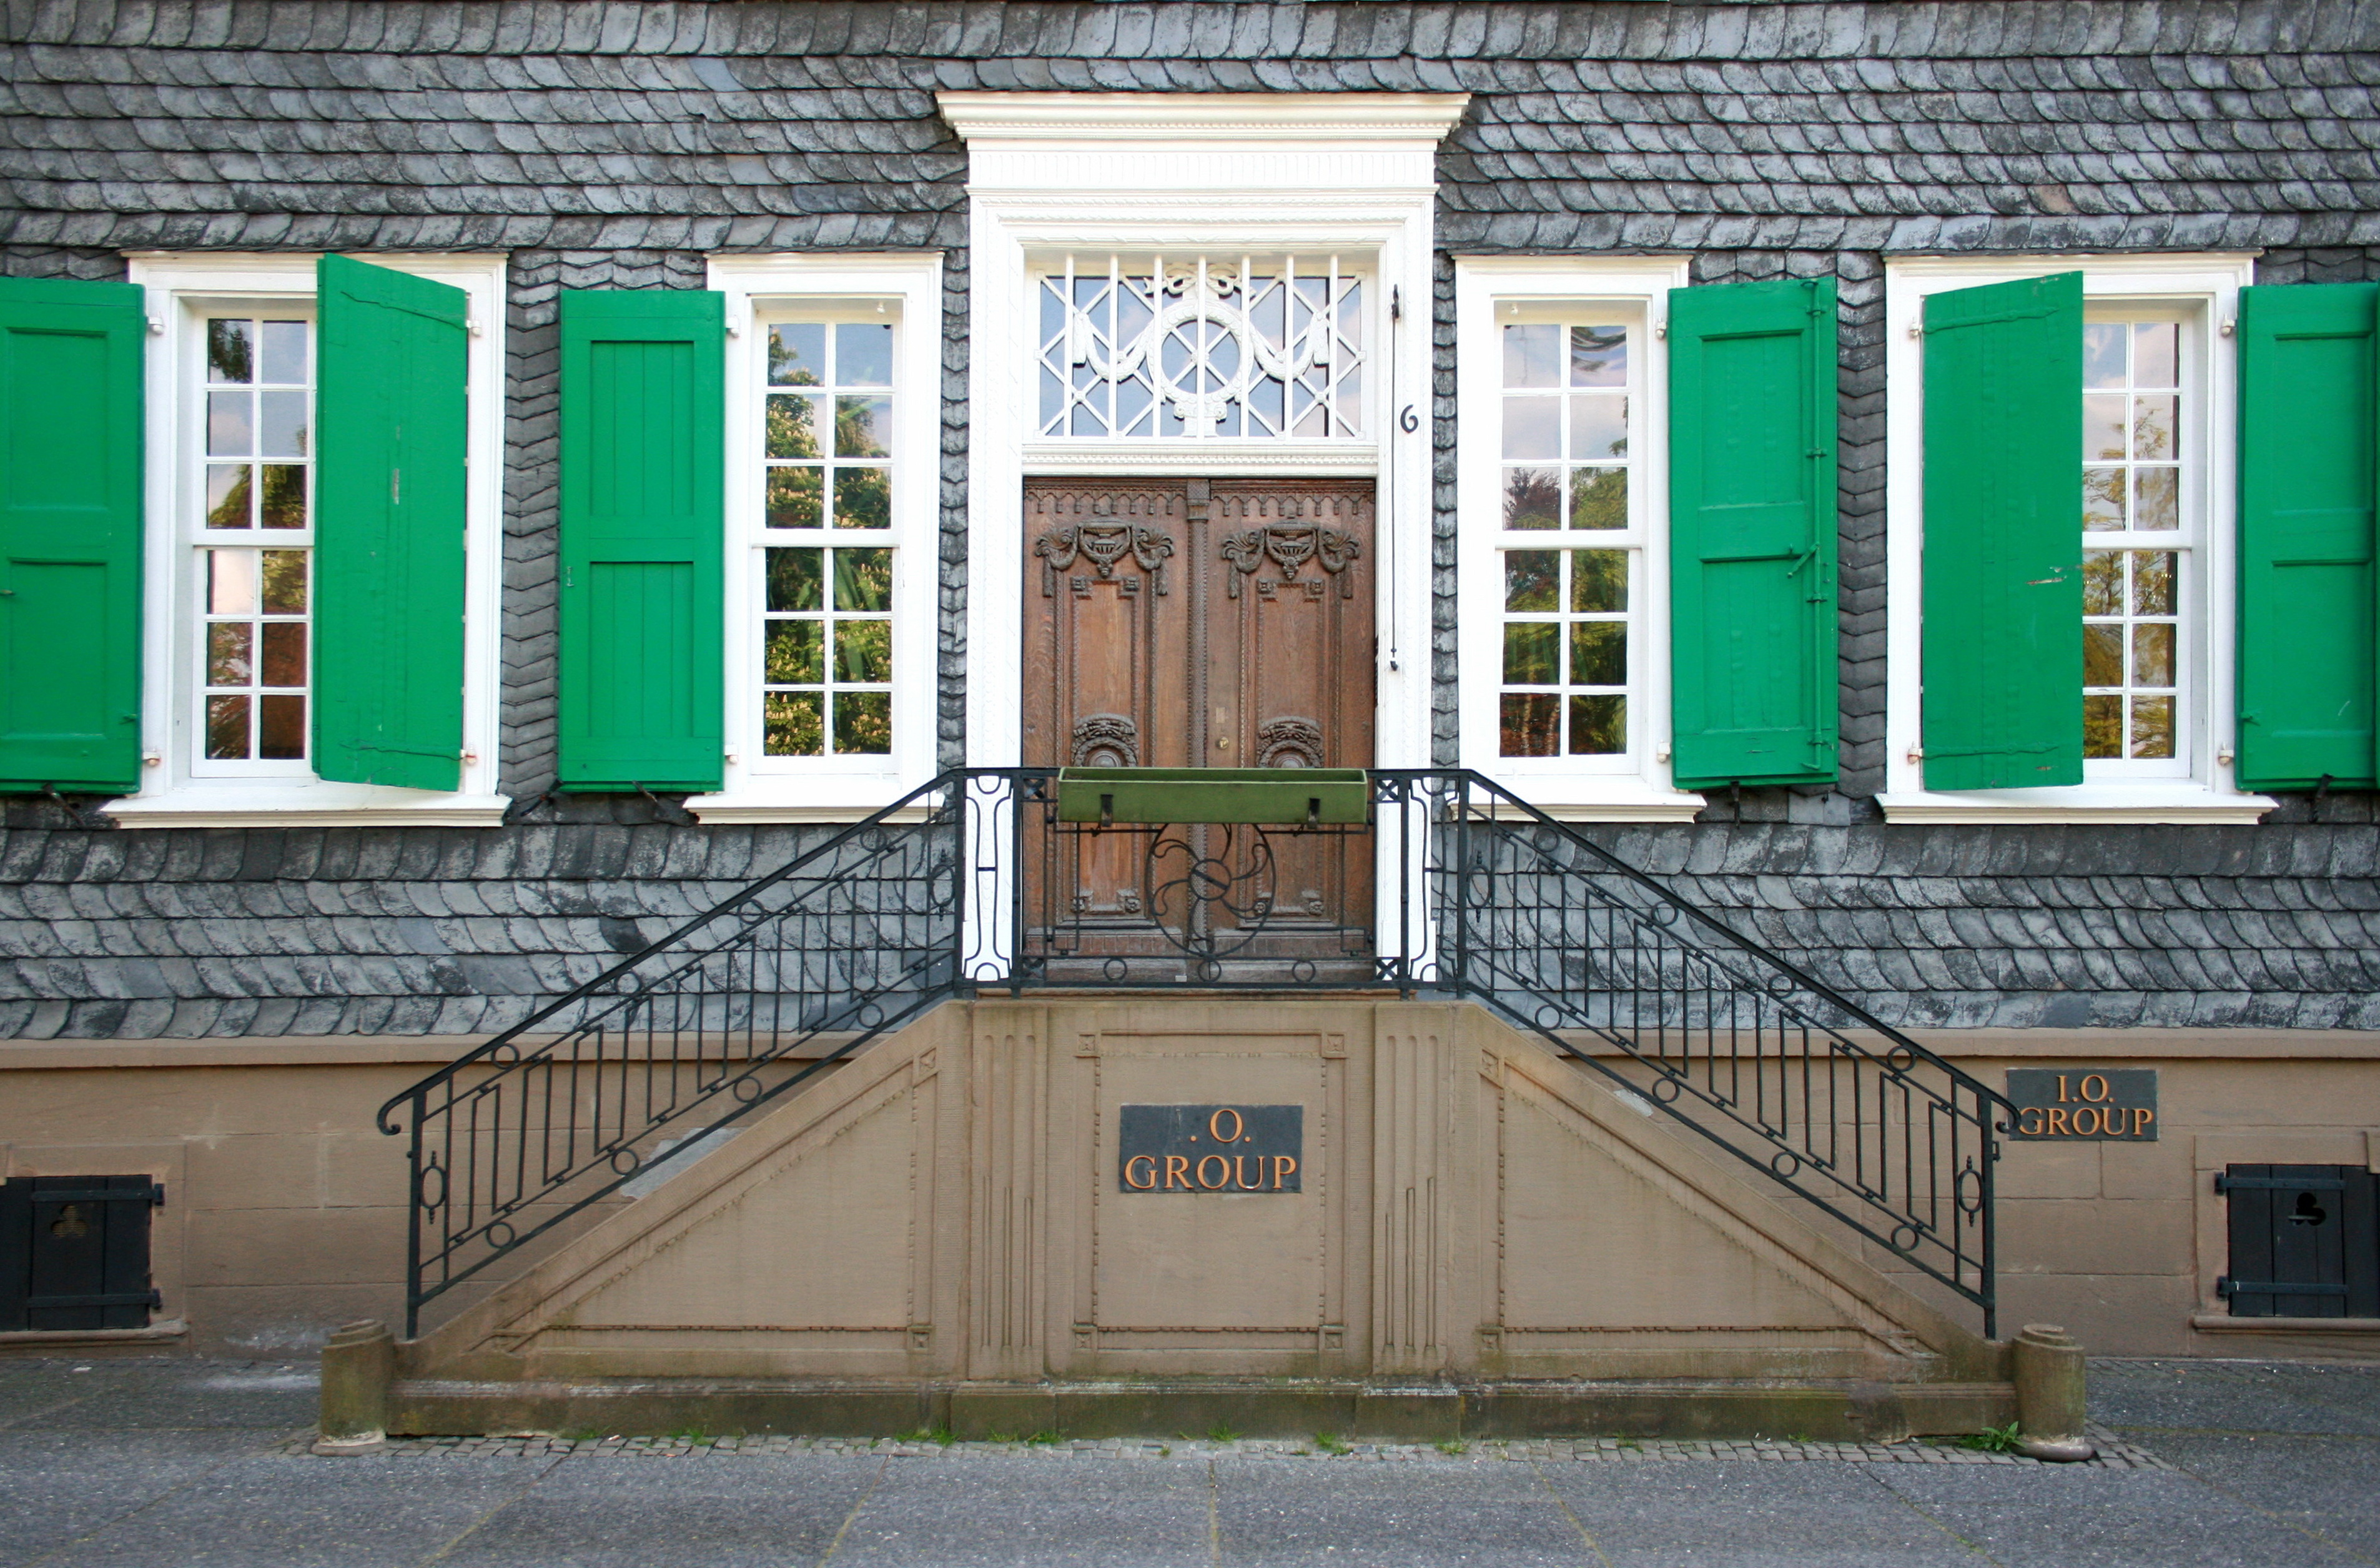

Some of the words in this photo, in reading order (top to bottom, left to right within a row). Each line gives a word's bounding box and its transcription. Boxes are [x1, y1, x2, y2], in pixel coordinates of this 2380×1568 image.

[1400, 404, 1419, 434] 6
[2058, 1074, 2115, 1103] I.O.
[2019, 1106, 2154, 1136] GROUP
[1125, 1155, 1297, 1190] GROUP
